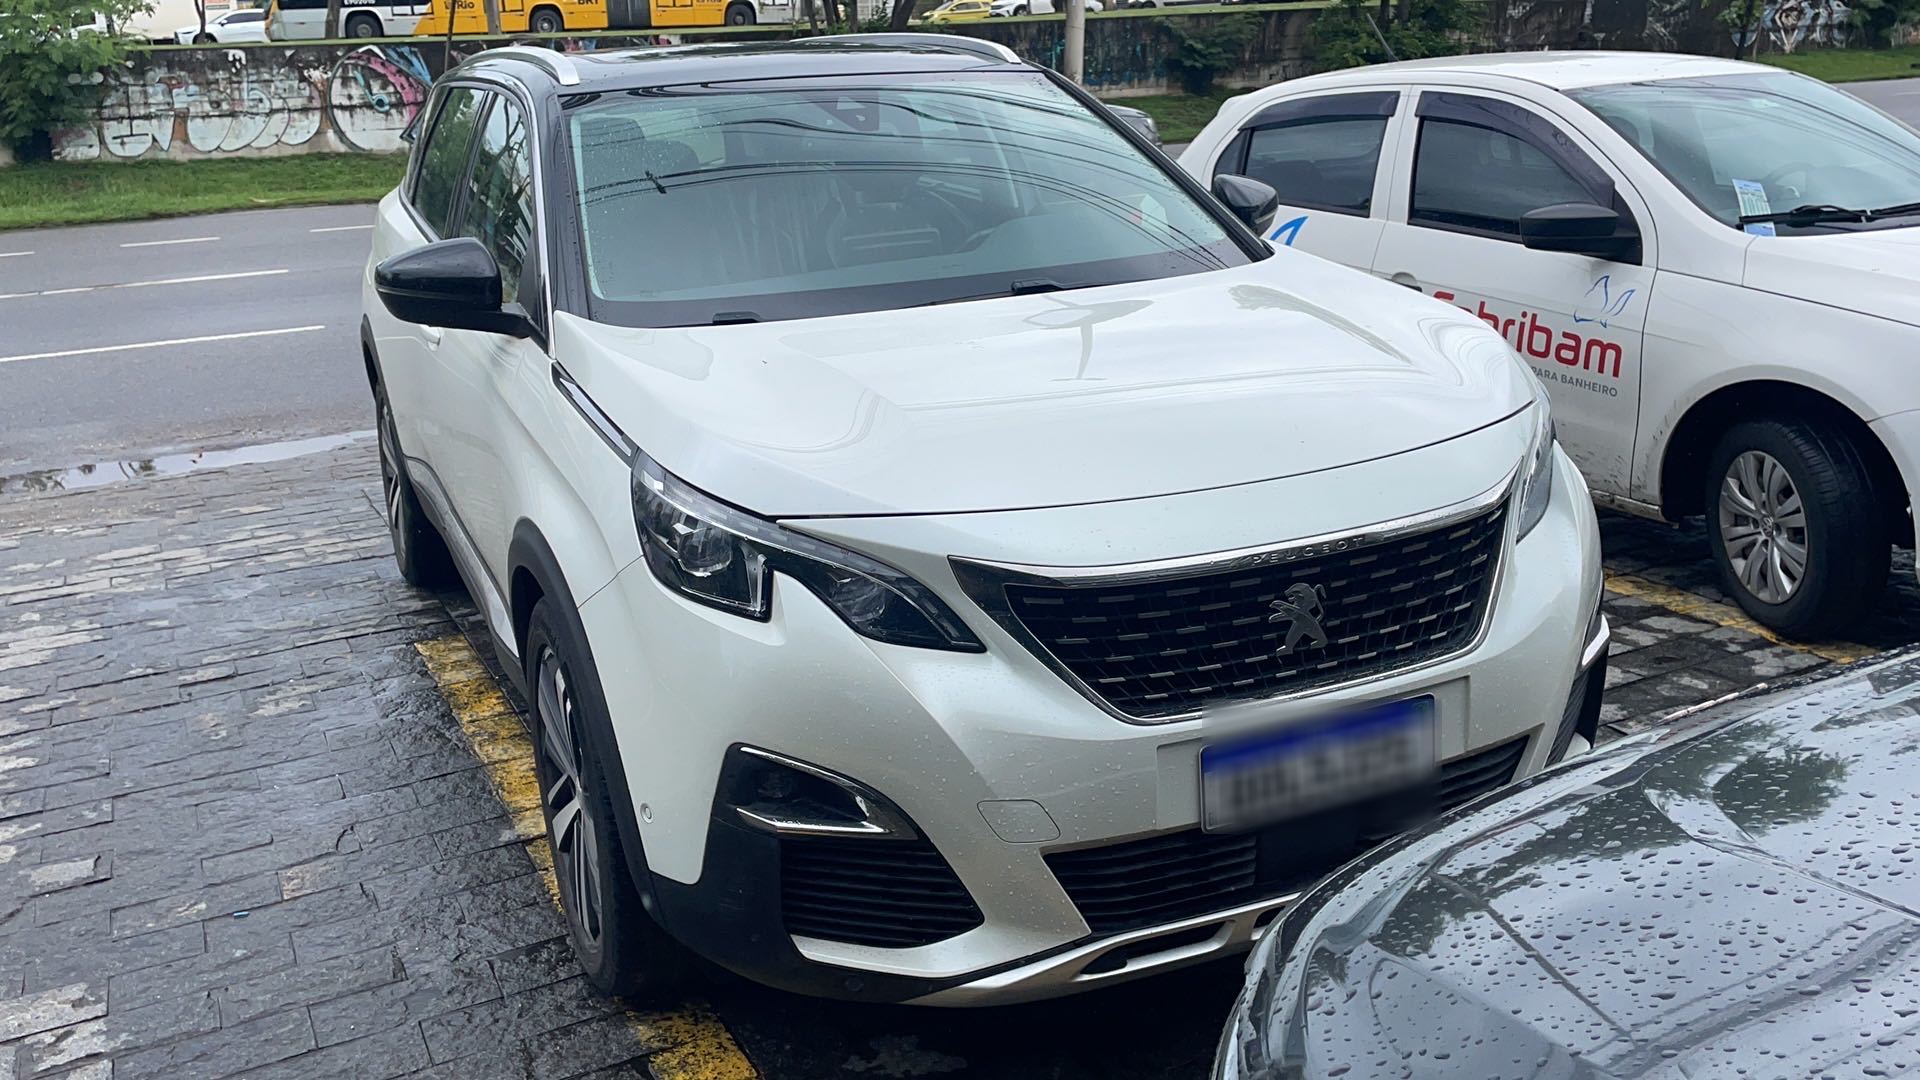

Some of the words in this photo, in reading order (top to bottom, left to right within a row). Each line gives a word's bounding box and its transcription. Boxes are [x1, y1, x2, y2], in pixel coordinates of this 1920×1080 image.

[457, 0, 475, 9] Rio
[1434, 291, 1623, 378] bribam
[1531, 366, 1558, 381] PARA
[1561, 374, 1618, 397] BANHEIRO
[1251, 537, 1364, 564] PEUGEOT
